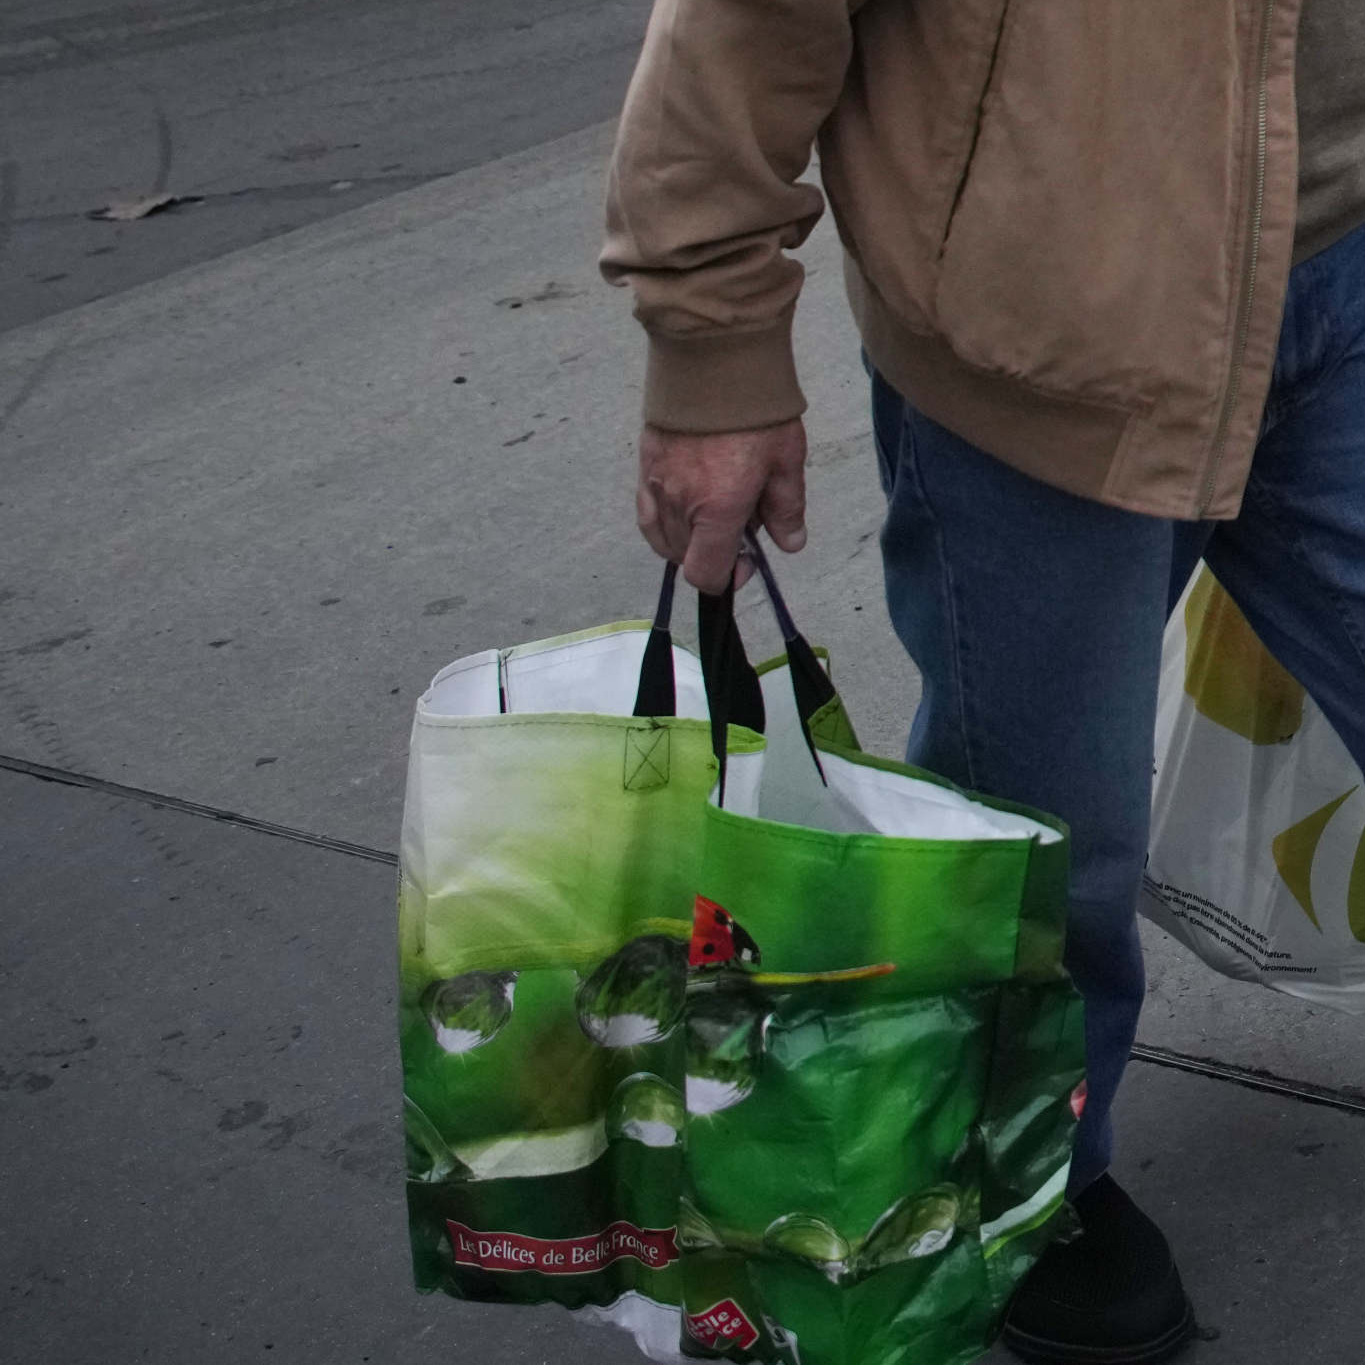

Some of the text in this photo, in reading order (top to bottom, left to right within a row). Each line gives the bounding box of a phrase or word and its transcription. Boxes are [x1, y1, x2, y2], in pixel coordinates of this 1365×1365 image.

[478, 1238, 537, 1265] Délices
[541, 1248, 566, 1266] de
[571, 1240, 611, 1266] Belle
[611, 1230, 660, 1261] France
